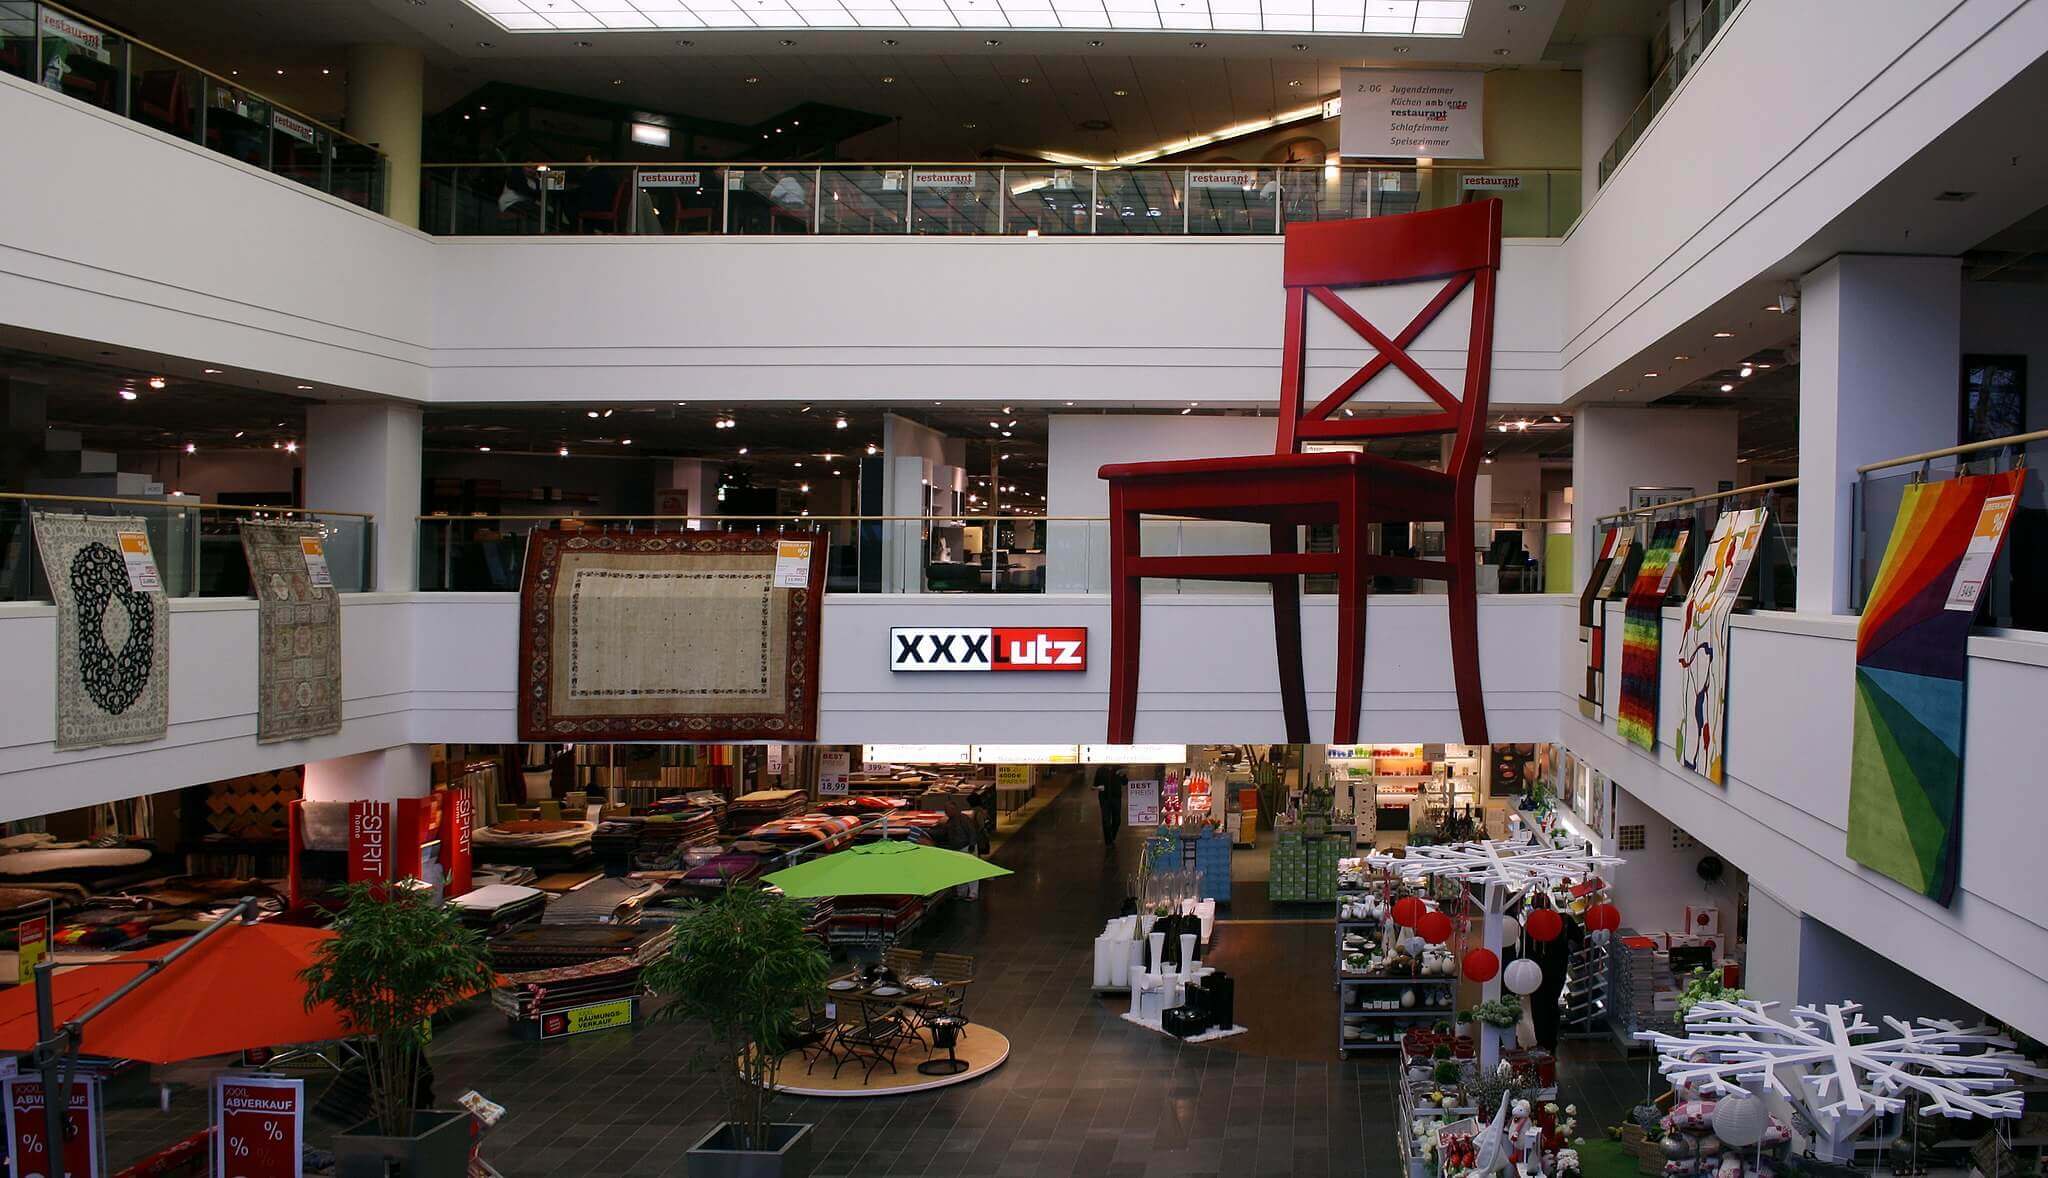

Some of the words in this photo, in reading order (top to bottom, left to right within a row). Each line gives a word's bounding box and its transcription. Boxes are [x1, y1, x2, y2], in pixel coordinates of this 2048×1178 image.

[44, 16, 99, 48] restaurant
[1369, 84, 1382, 92] OG
[1391, 85, 1454, 95] Jugendzimmer
[1391, 97, 1422, 106] Küchen
[1391, 109, 1448, 119] restaurant
[1391, 123, 1449, 133] Schlafzimmer
[1391, 137, 1450, 147] Speisezimmer
[641, 174, 697, 184] restaurant
[916, 174, 972, 183] restaurant
[1193, 173, 1249, 184] restaurant
[1465, 177, 1520, 186] restaurant
[896, 633, 1082, 665] XXXLutz
[460, 787, 471, 856] ESPRIT
[363, 801, 382, 877] ESPRIT
[226, 1098, 293, 1110] ABVERKAUF
